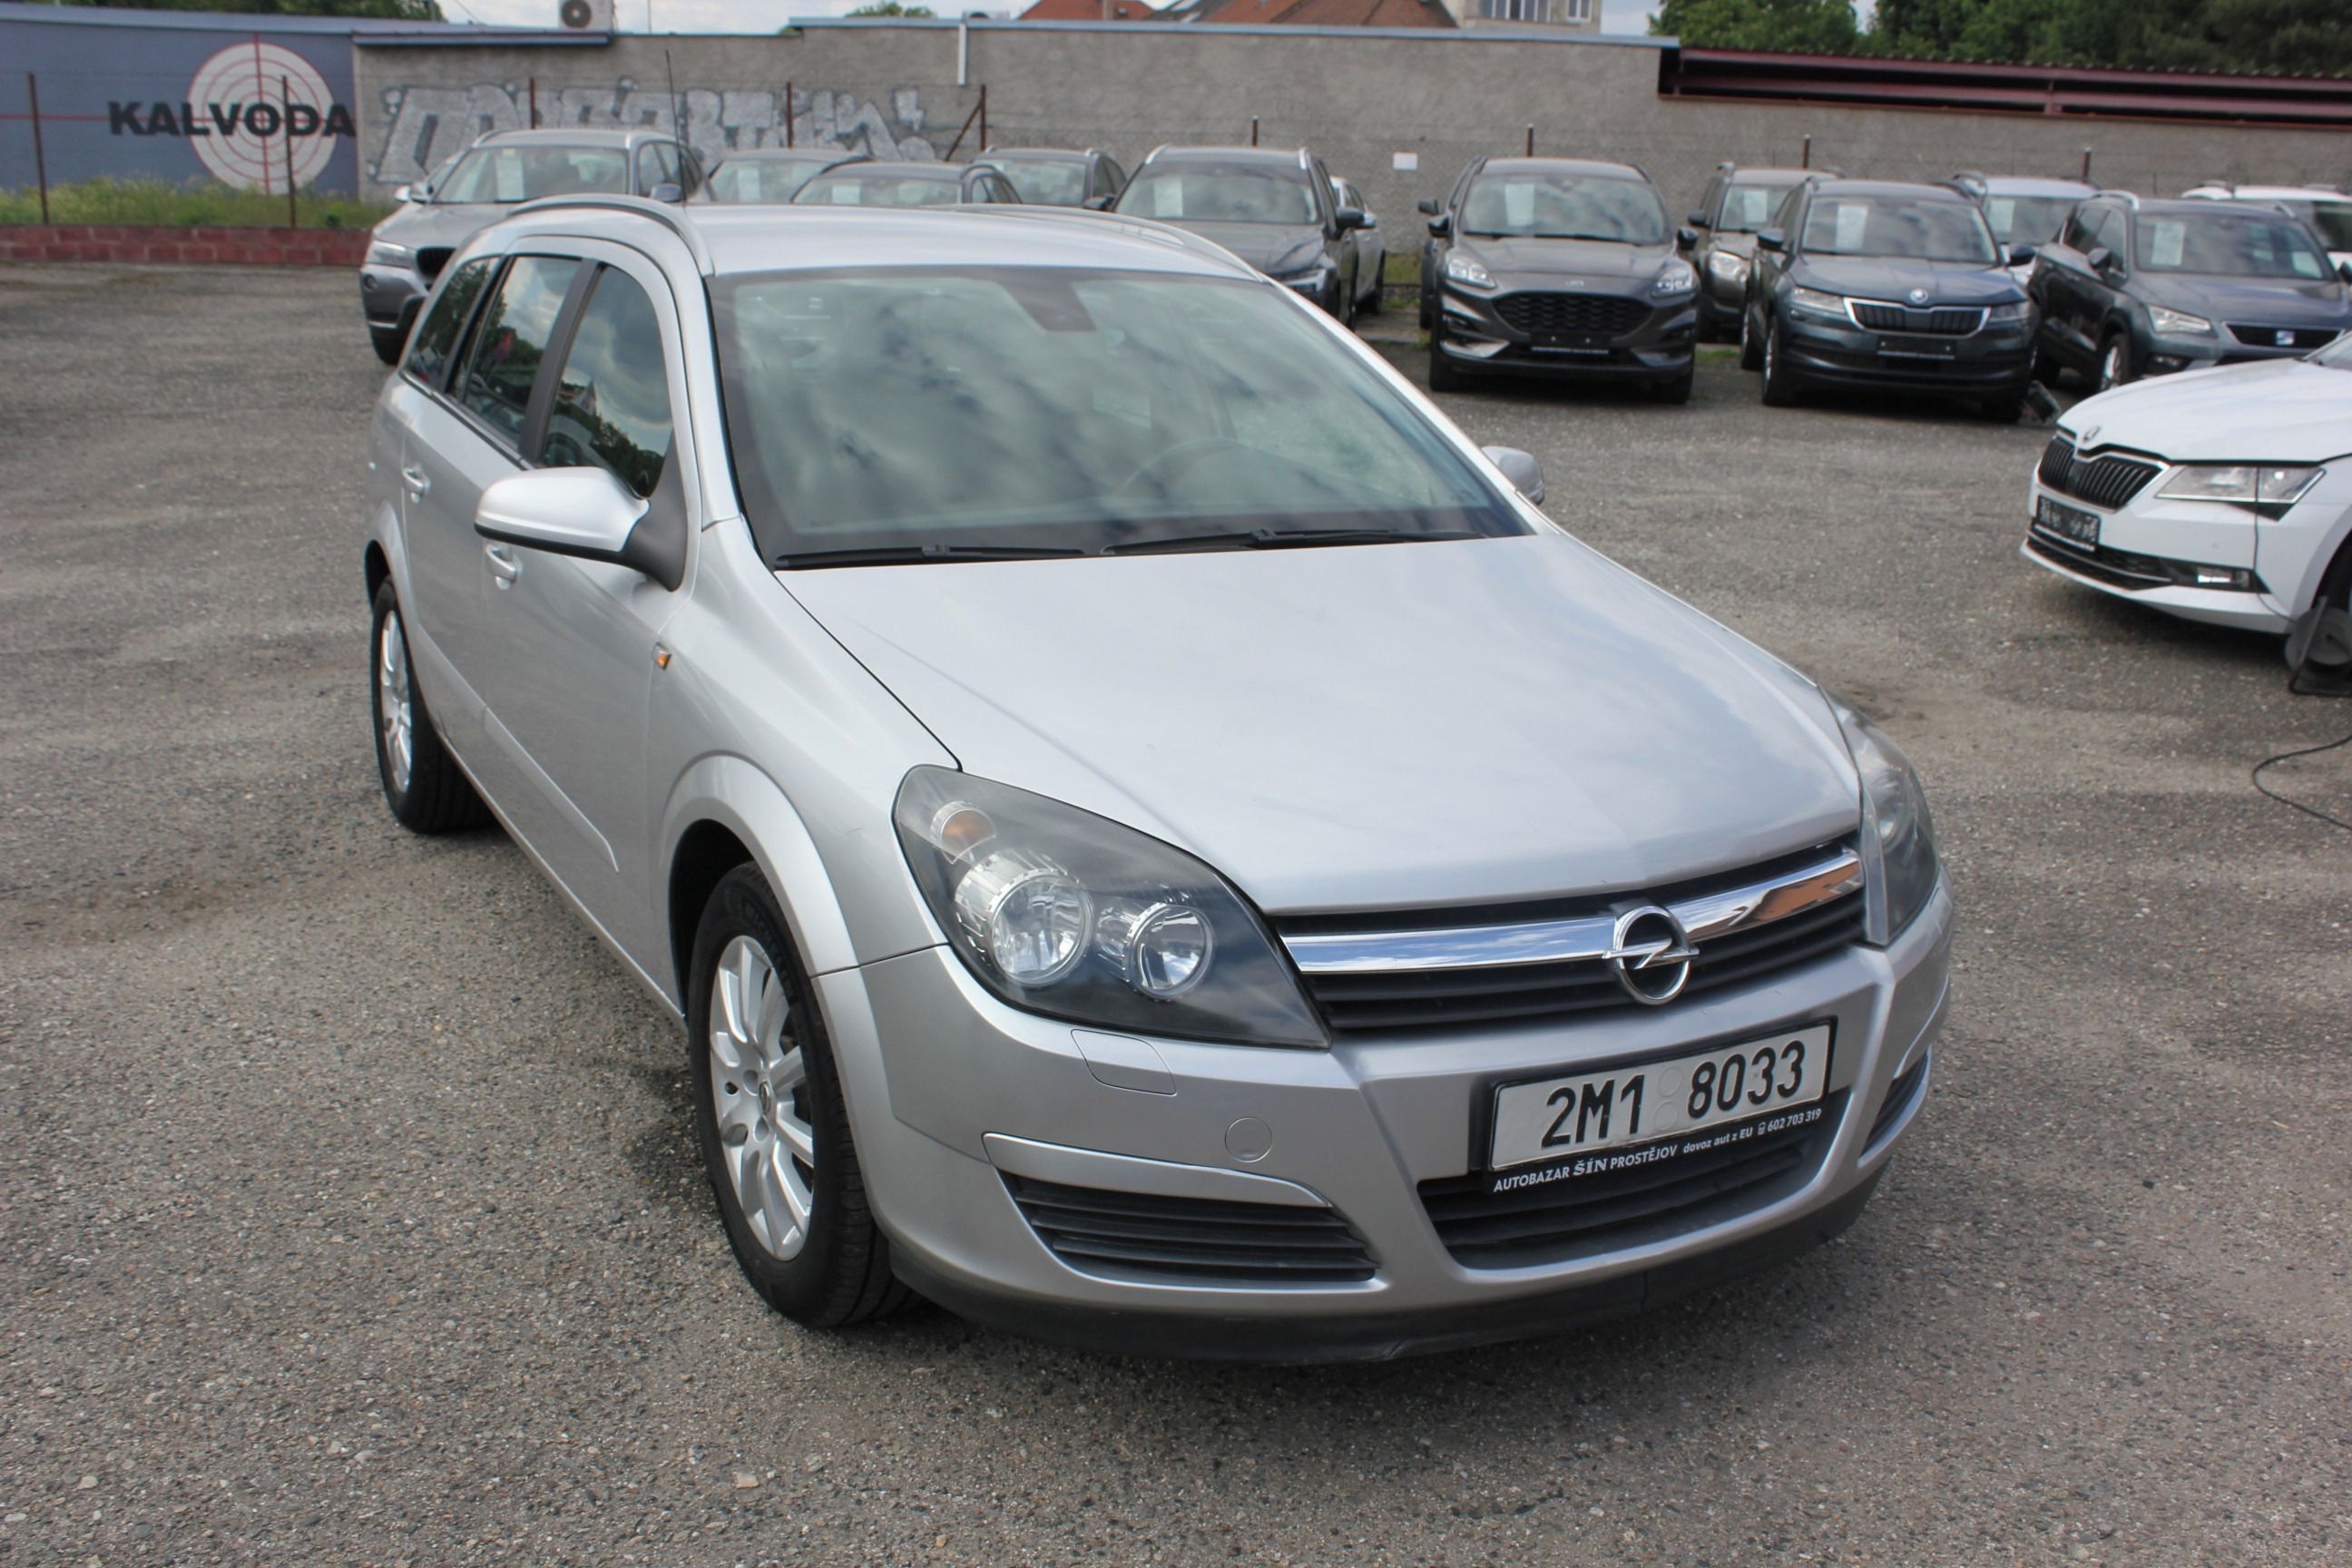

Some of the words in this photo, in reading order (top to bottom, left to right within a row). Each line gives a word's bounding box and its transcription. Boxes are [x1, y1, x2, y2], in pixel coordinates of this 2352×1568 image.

[108, 101, 357, 139] KALVODA
[1541, 1074, 1645, 1149] 2M1
[1687, 1040, 1806, 1119] 8033
[1493, 1166, 1571, 1193] AUTOBAZAR
[1572, 1158, 1608, 1177] ŠÍN
[1610, 1145, 1678, 1170] PROSTĚJOV
[1682, 1140, 1713, 1154] dovoz
[1713, 1132, 1730, 1146] aut
[1739, 1127, 1754, 1141] EU
[1767, 1117, 1786, 1132] 602
[1786, 1114, 1805, 1127] 703
[1805, 1108, 1822, 1122] 319
